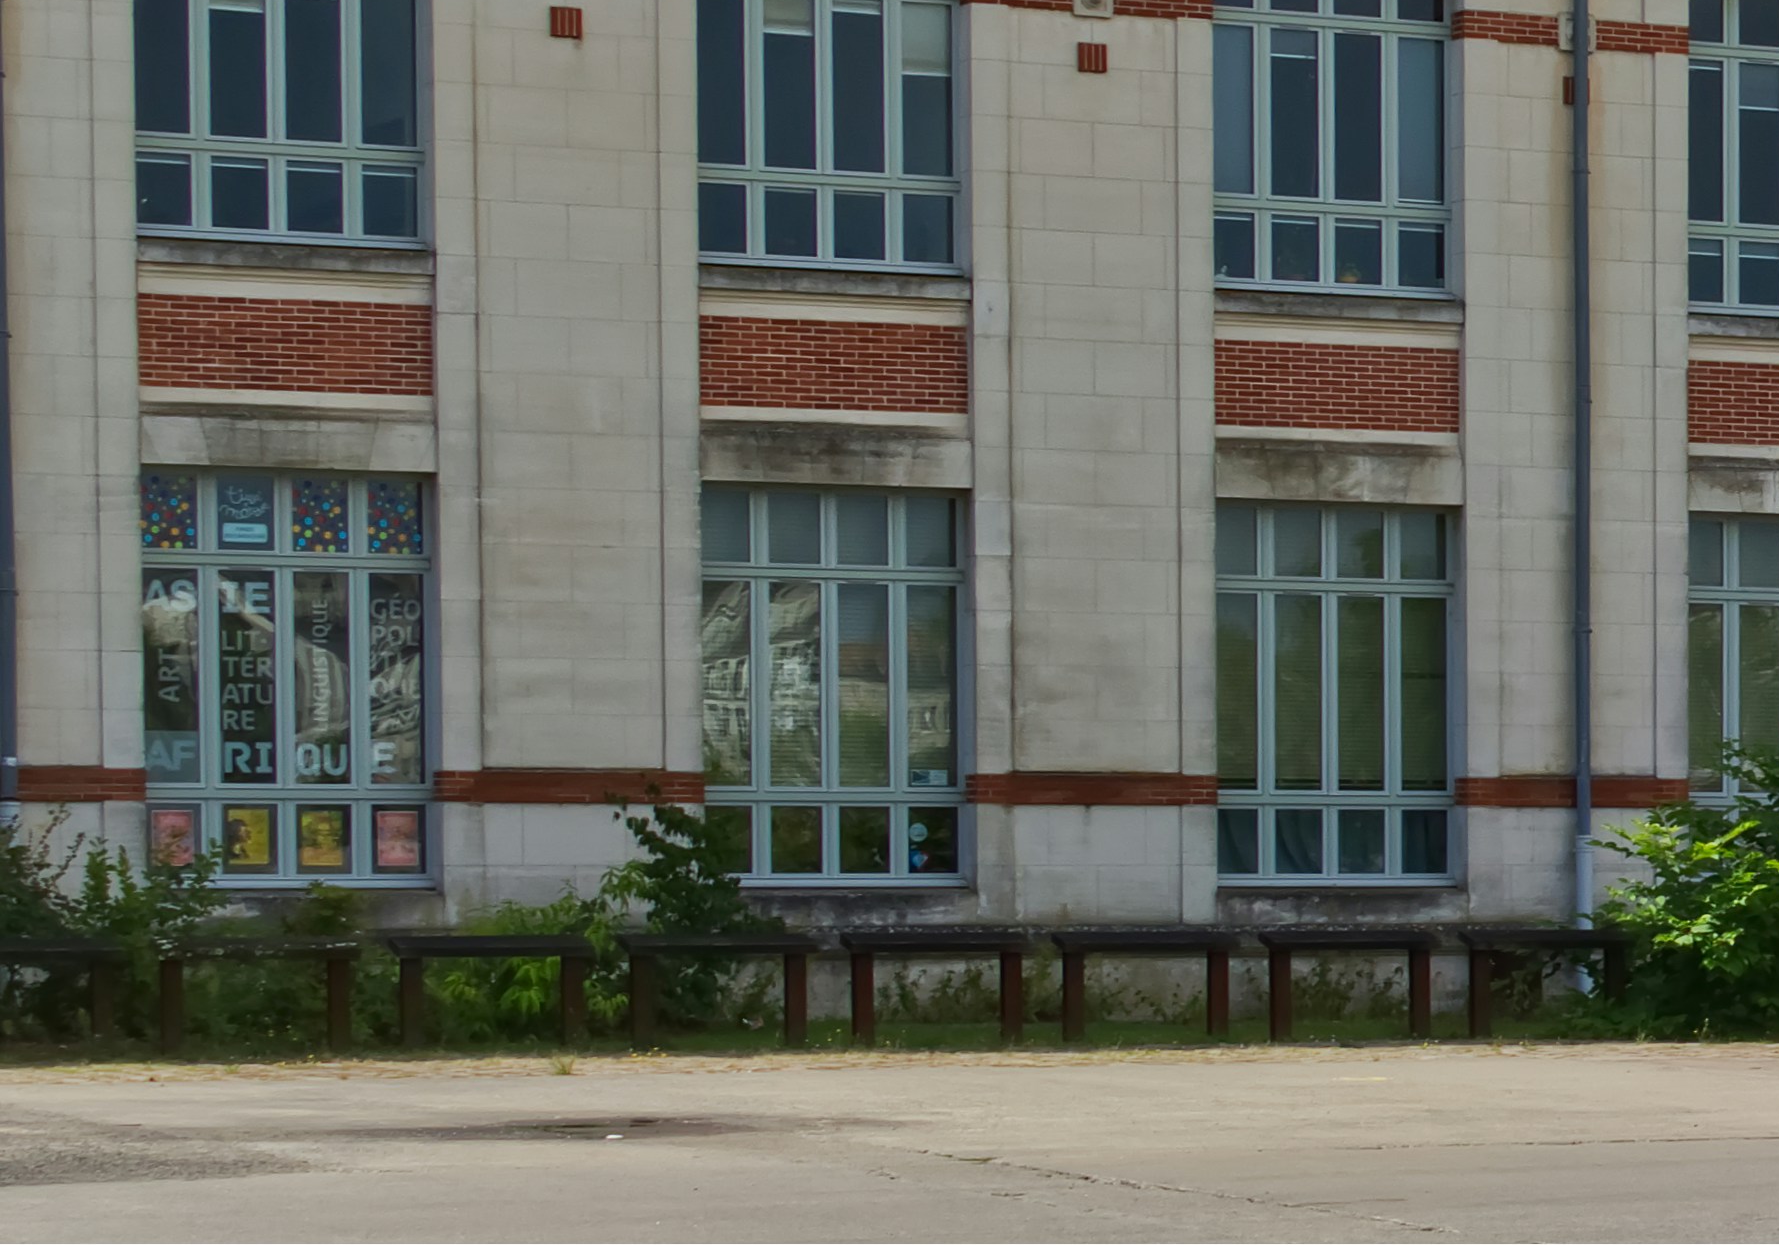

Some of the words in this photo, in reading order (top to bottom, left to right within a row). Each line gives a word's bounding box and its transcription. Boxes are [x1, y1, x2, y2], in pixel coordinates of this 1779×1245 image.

[143, 579, 271, 614] ASIE
[370, 593, 422, 622] GÉO
[370, 625, 420, 646] POL
[158, 648, 181, 703] ART
[221, 652, 274, 679] TÉR
[312, 599, 333, 733] LINGUISTIQUE
[221, 683, 274, 705] ATU
[222, 710, 256, 731] RE
[150, 738, 397, 777] AFRIQUE
